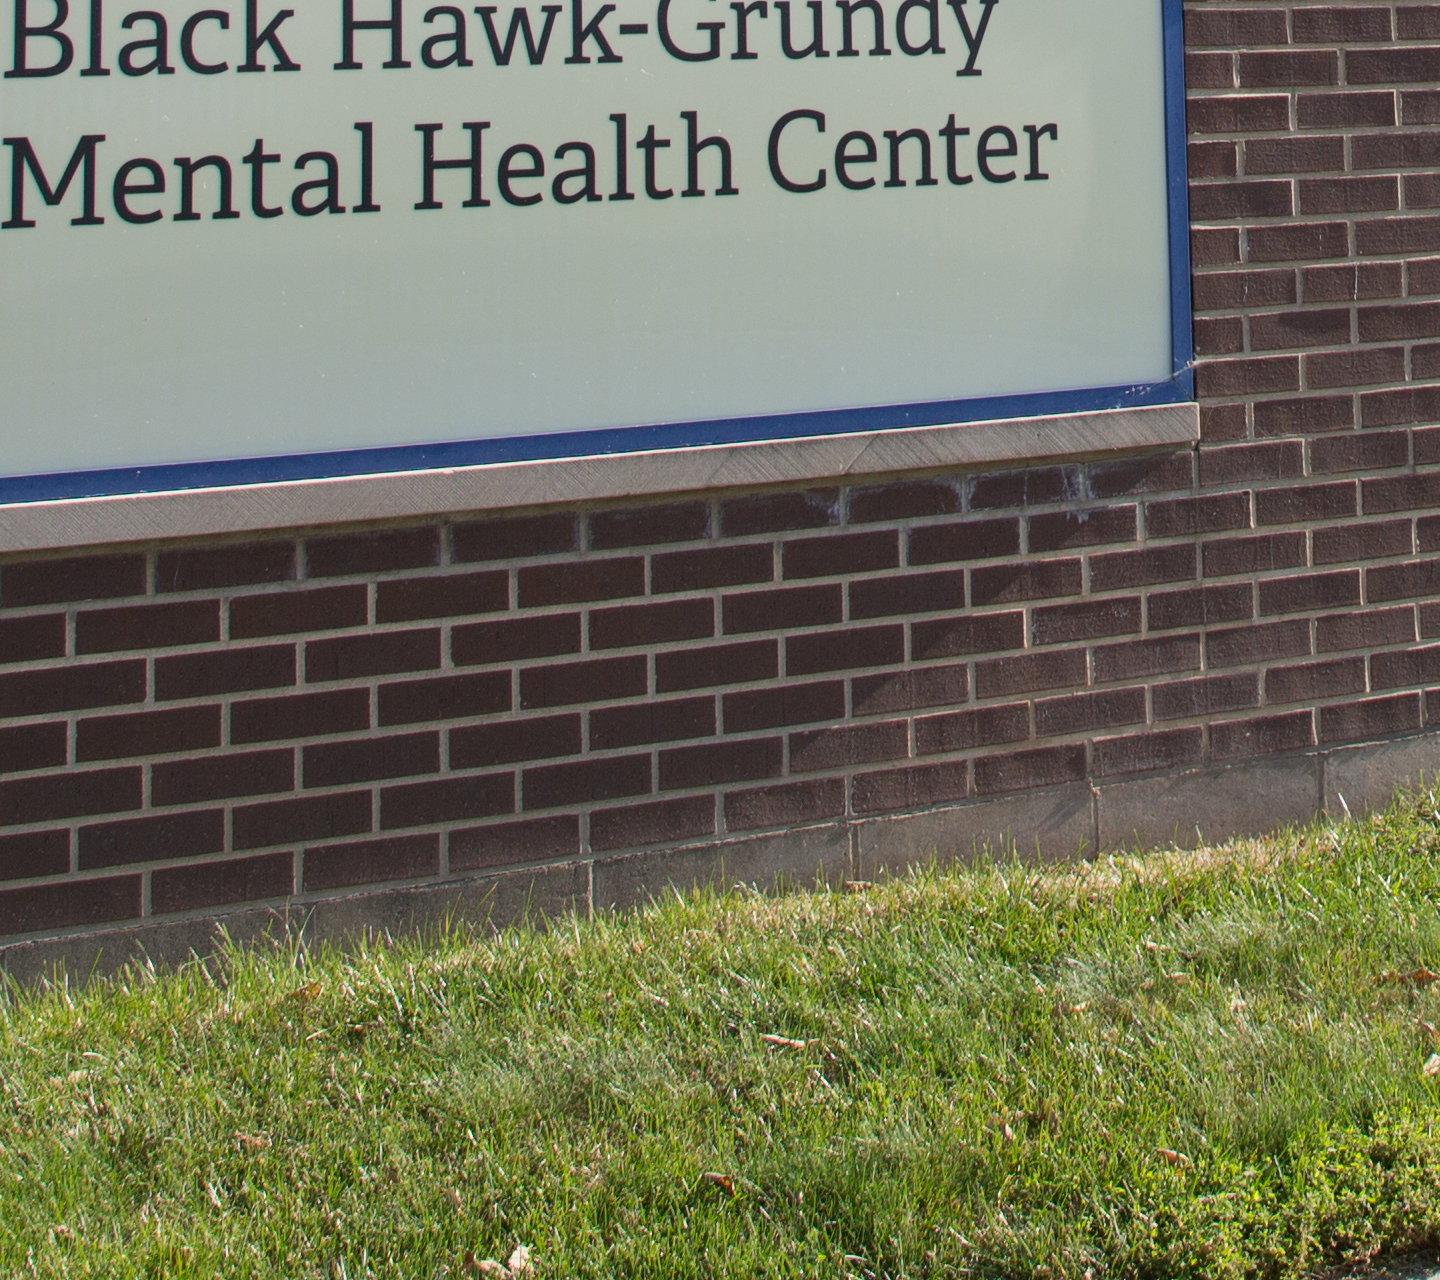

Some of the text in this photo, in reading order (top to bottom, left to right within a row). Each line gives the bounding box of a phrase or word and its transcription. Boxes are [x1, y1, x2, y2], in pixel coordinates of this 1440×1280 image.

[0, 108, 1058, 230] Mental Health Center
